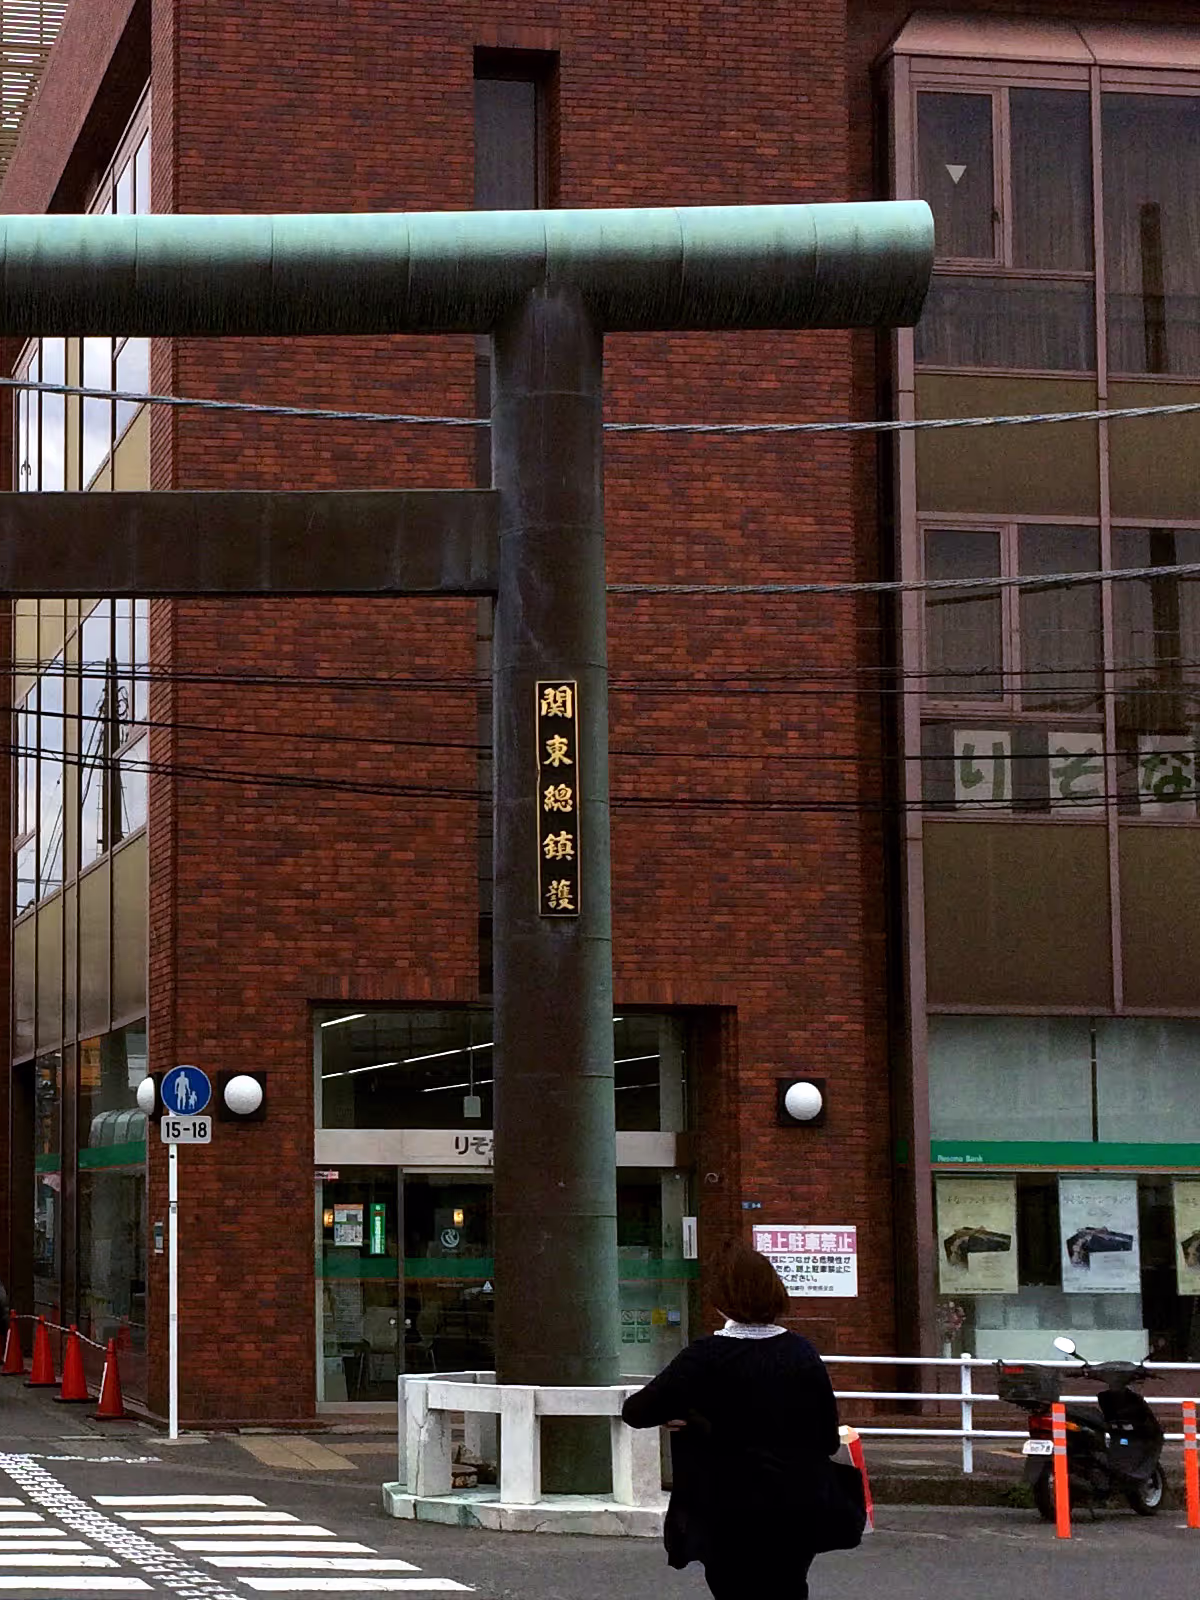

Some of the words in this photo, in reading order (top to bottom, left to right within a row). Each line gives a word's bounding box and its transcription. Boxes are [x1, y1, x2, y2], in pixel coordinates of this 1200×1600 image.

[166, 1122, 207, 1138] 15-18
[756, 1233, 854, 1252] 路上駐車禁止
